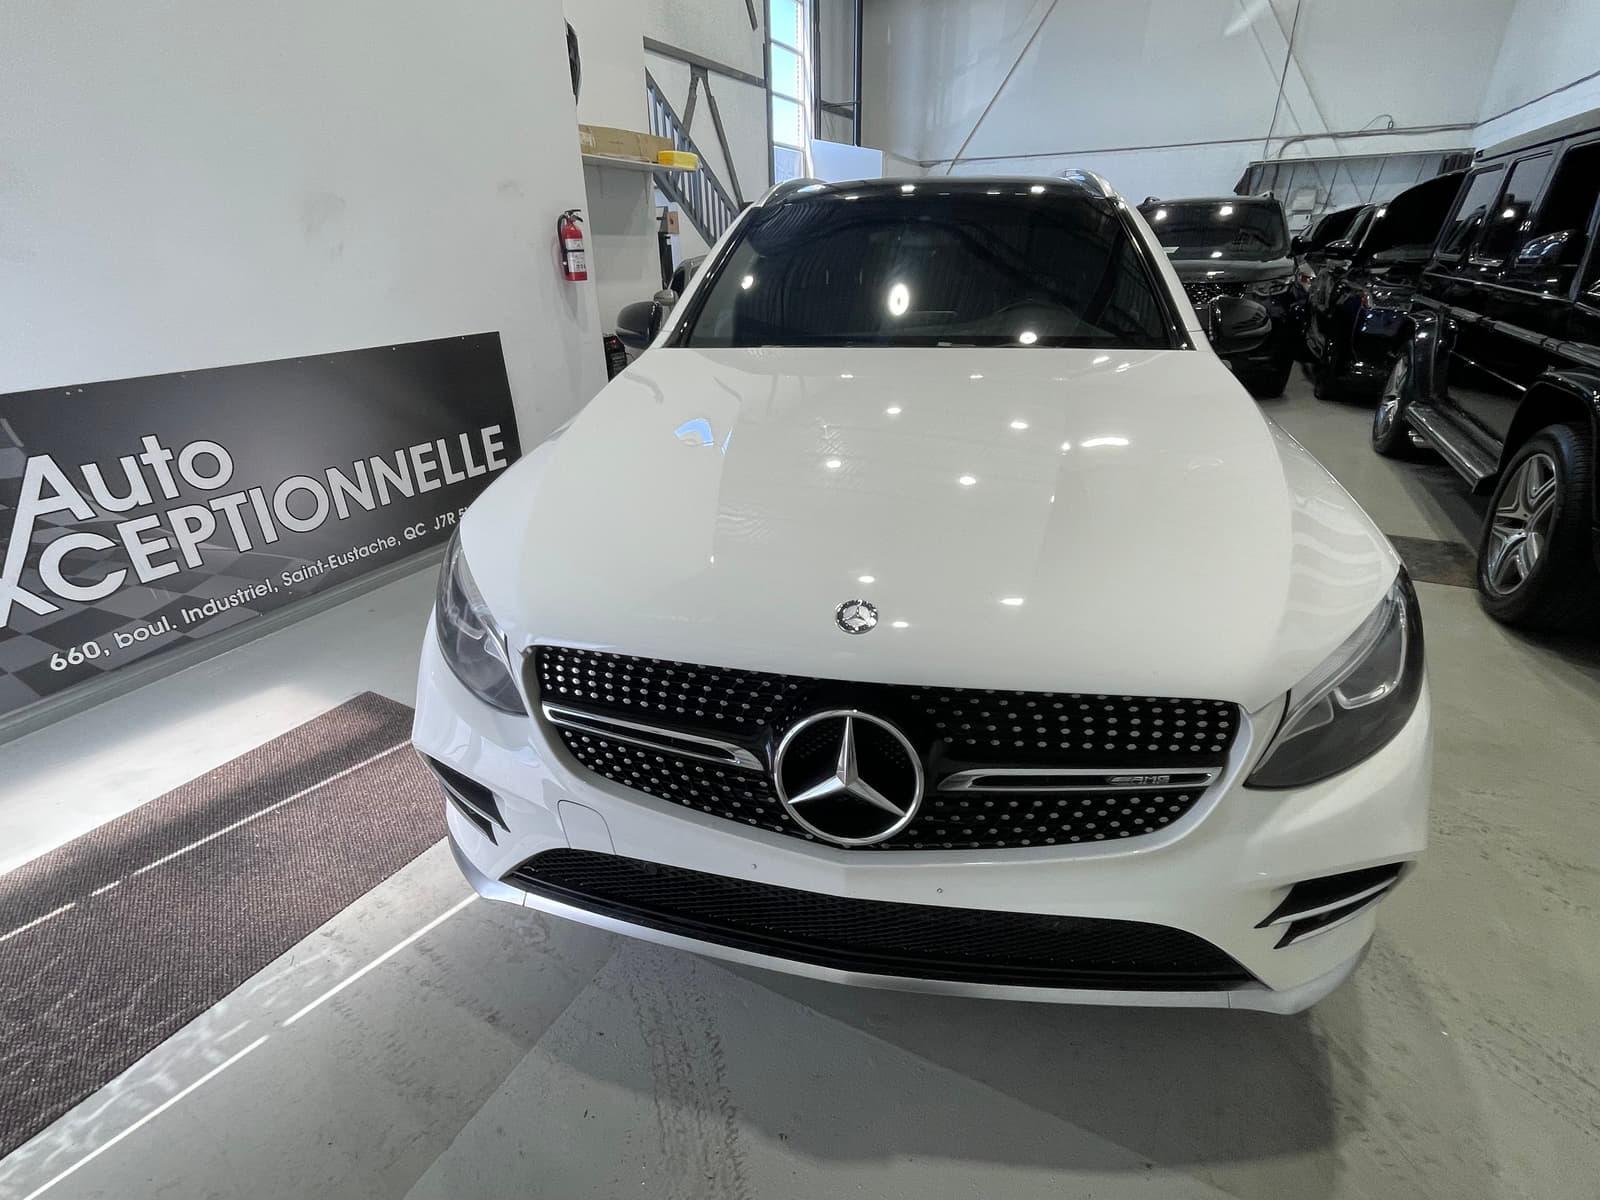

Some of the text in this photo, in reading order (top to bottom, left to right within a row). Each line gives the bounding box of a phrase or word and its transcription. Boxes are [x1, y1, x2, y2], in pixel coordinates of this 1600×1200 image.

[17, 434, 234, 521] Auto
[50, 640, 110, 671] 660,
[113, 616, 177, 649] boul.
[180, 578, 279, 624] Industriel,
[281, 535, 401, 587] Saint-Eustache,
[403, 522, 427, 540] QC
[433, 511, 456, 530] J7R
